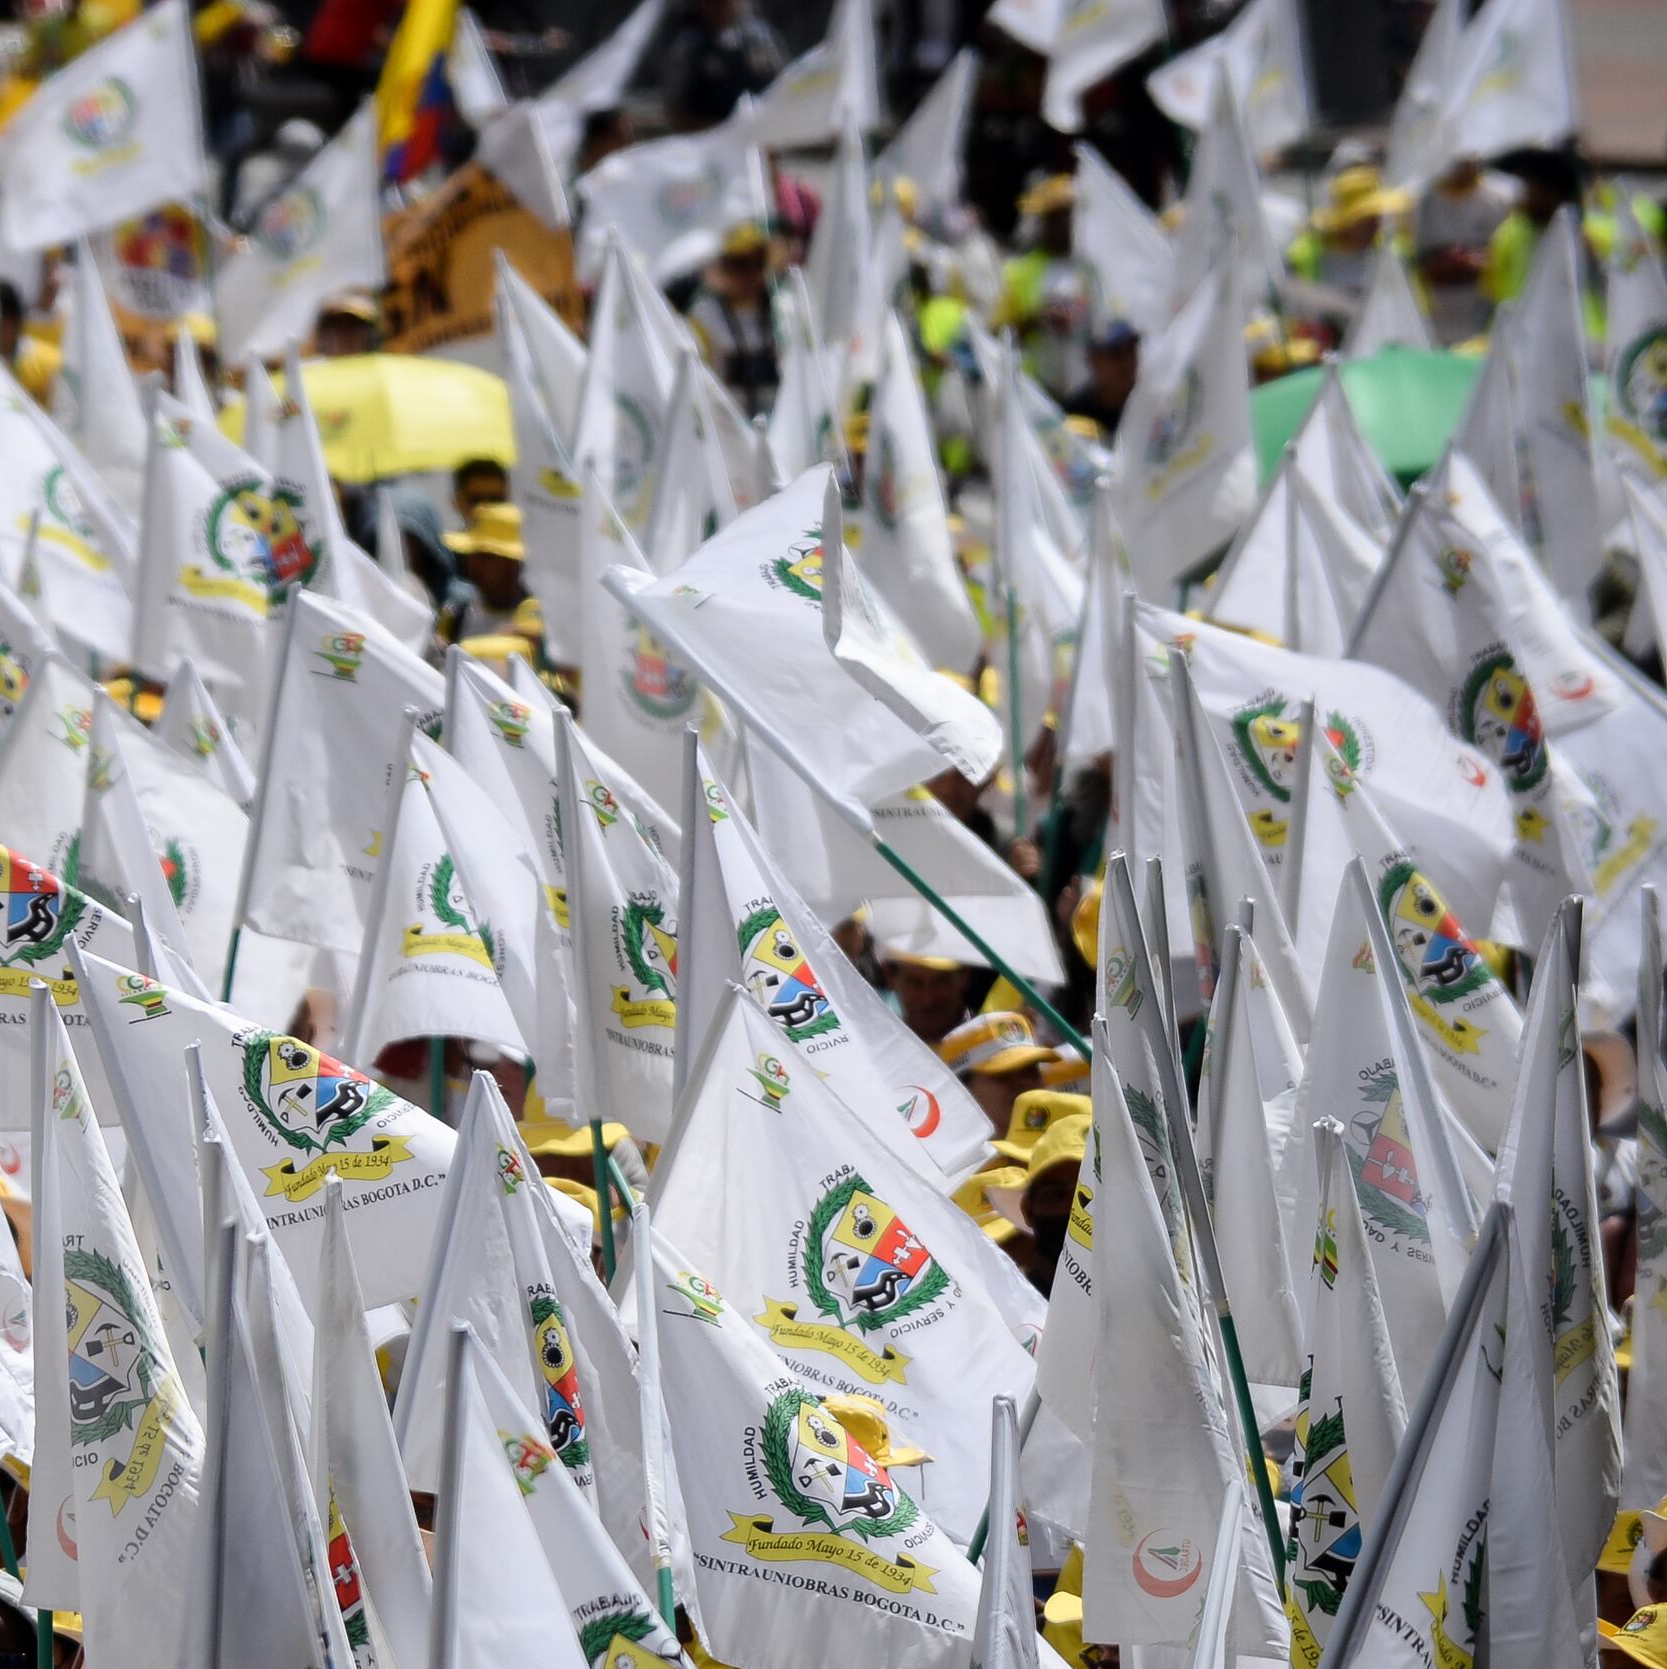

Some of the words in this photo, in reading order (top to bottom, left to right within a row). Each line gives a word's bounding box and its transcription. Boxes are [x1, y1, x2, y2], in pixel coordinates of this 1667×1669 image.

[611, 905, 627, 973] HUMILDAD
[806, 1034, 850, 1054] RVICIO
[236, 1086, 280, 1147] HUMILDAD
[285, 1171, 319, 1199] Fundado
[337, 1158, 350, 1171] 15
[351, 1157, 363, 1169] de
[364, 1153, 390, 1169] 1934
[360, 1182, 409, 1207] BOGOTA
[410, 1173, 446, 1197] D.C.”
[787, 1218, 804, 1288] HUMILDAD
[772, 1323, 814, 1347] Fundado
[816, 1333, 844, 1355] Mayo
[844, 1341, 858, 1358] 15
[856, 1345, 868, 1361] de
[867, 1352, 891, 1378] 1934
[889, 1309, 947, 1339] SERVICIO
[765, 1377, 799, 1396] TRABA
[742, 1425, 768, 1500] HUMILDAD
[748, 1536, 802, 1556] Fundado
[803, 1539, 844, 1562] Mayo
[845, 1550, 862, 1567] 15
[862, 1556, 879, 1573] de
[880, 1564, 913, 1589] 1934
[1450, 1497, 1491, 1587] HUMILDAD
[692, 1551, 849, 1602] “SINTRAUNIOBRAS
[851, 1589, 922, 1625] BOGOTA
[925, 1610, 965, 1635] D.C.”
